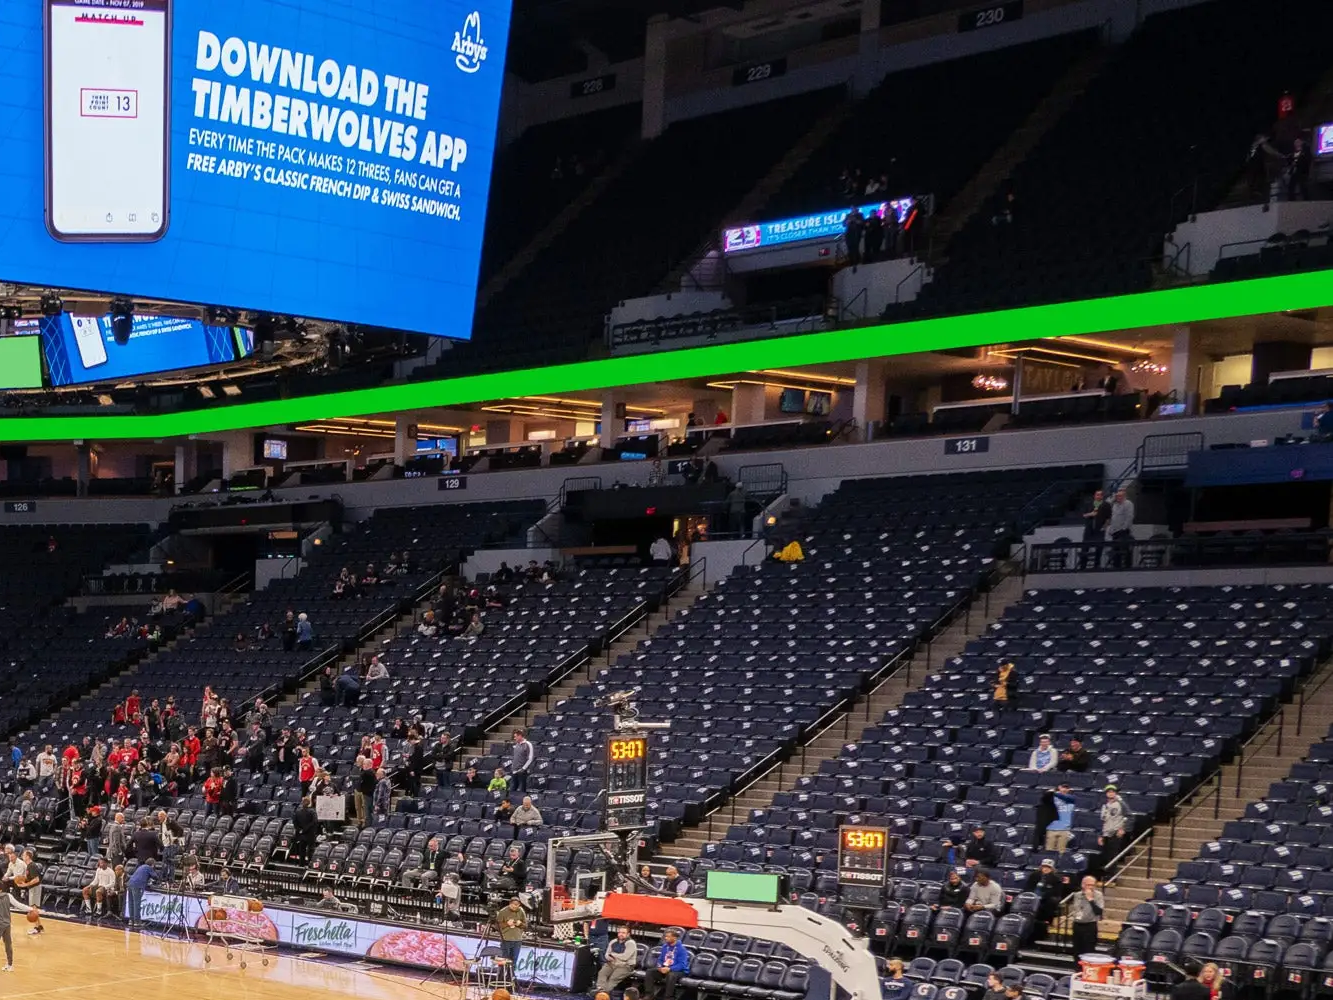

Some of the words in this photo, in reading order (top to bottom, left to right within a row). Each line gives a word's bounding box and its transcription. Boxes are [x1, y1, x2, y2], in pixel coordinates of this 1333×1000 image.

[81, 13, 118, 22] MATCH
[123, 15, 136, 23] UP
[975, 7, 1005, 26] 230
[196, 30, 379, 107] DOWNLOAD
[383, 75, 430, 120] THE
[746, 64, 771, 82] 229
[116, 95, 131, 111] 13
[191, 78, 417, 161] TIMBERWOLVES
[420, 131, 468, 173] APP
[188, 127, 227, 148] EVERY
[227, 134, 255, 155] TIME
[256, 140, 276, 160] THE
[277, 145, 306, 166] PACK
[306, 150, 343, 173] MAKES
[345, 158, 357, 176] 12
[357, 160, 392, 185] THREES,
[394, 168, 418, 189] FANS
[418, 173, 438, 193] CAN
[438, 178, 454, 196] GET
[453, 183, 461, 198] A
[186, 152, 216, 173] FREE
[262, 166, 308, 189] CLASSIC
[309, 176, 352, 199] FRENCH
[352, 183, 371, 201] DIP
[371, 187, 380, 204] &
[381, 189, 412, 210] SWISS
[411, 194, 461, 221] SANDWICH.
[767, 216, 821, 235] TREASURE
[954, 439, 978, 452] 131
[444, 478, 460, 489] 129
[13, 503, 28, 511] 126
[611, 740, 643, 759] 53:07
[619, 793, 645, 804] TISSOT
[847, 832, 884, 848] 53:07
[851, 872, 883, 881] TISSOT
[295, 919, 354, 943] Freschetta
[515, 949, 564, 972] chetta
[822, 944, 850, 973] SPALDING
[917, 983, 929, 996] G
[945, 988, 958, 1000] G
[1082, 983, 1122, 993] GATORADE
